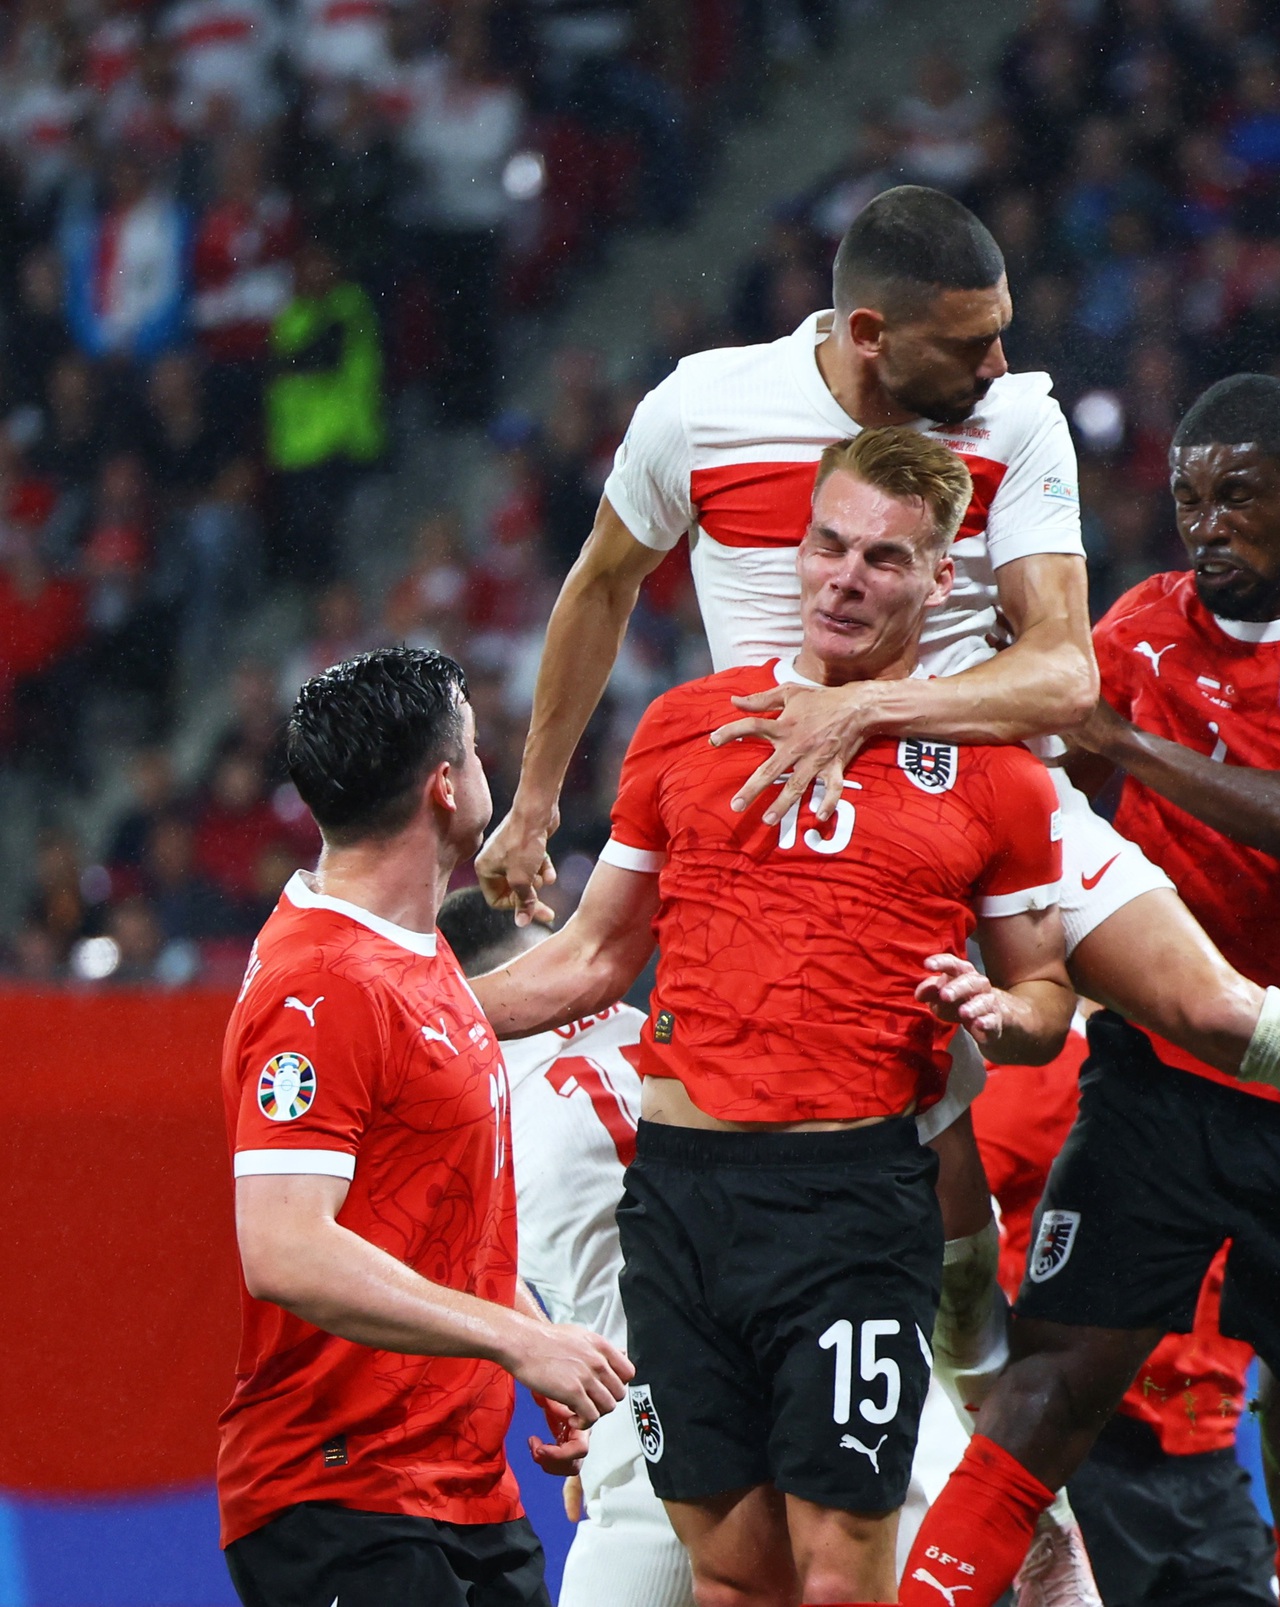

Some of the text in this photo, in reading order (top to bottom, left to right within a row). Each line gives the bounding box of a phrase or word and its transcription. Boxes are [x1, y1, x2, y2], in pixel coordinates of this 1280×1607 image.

[773, 772, 863, 854] 15
[818, 1319, 901, 1425] 15
[925, 1545, 976, 1576] ÖFB
